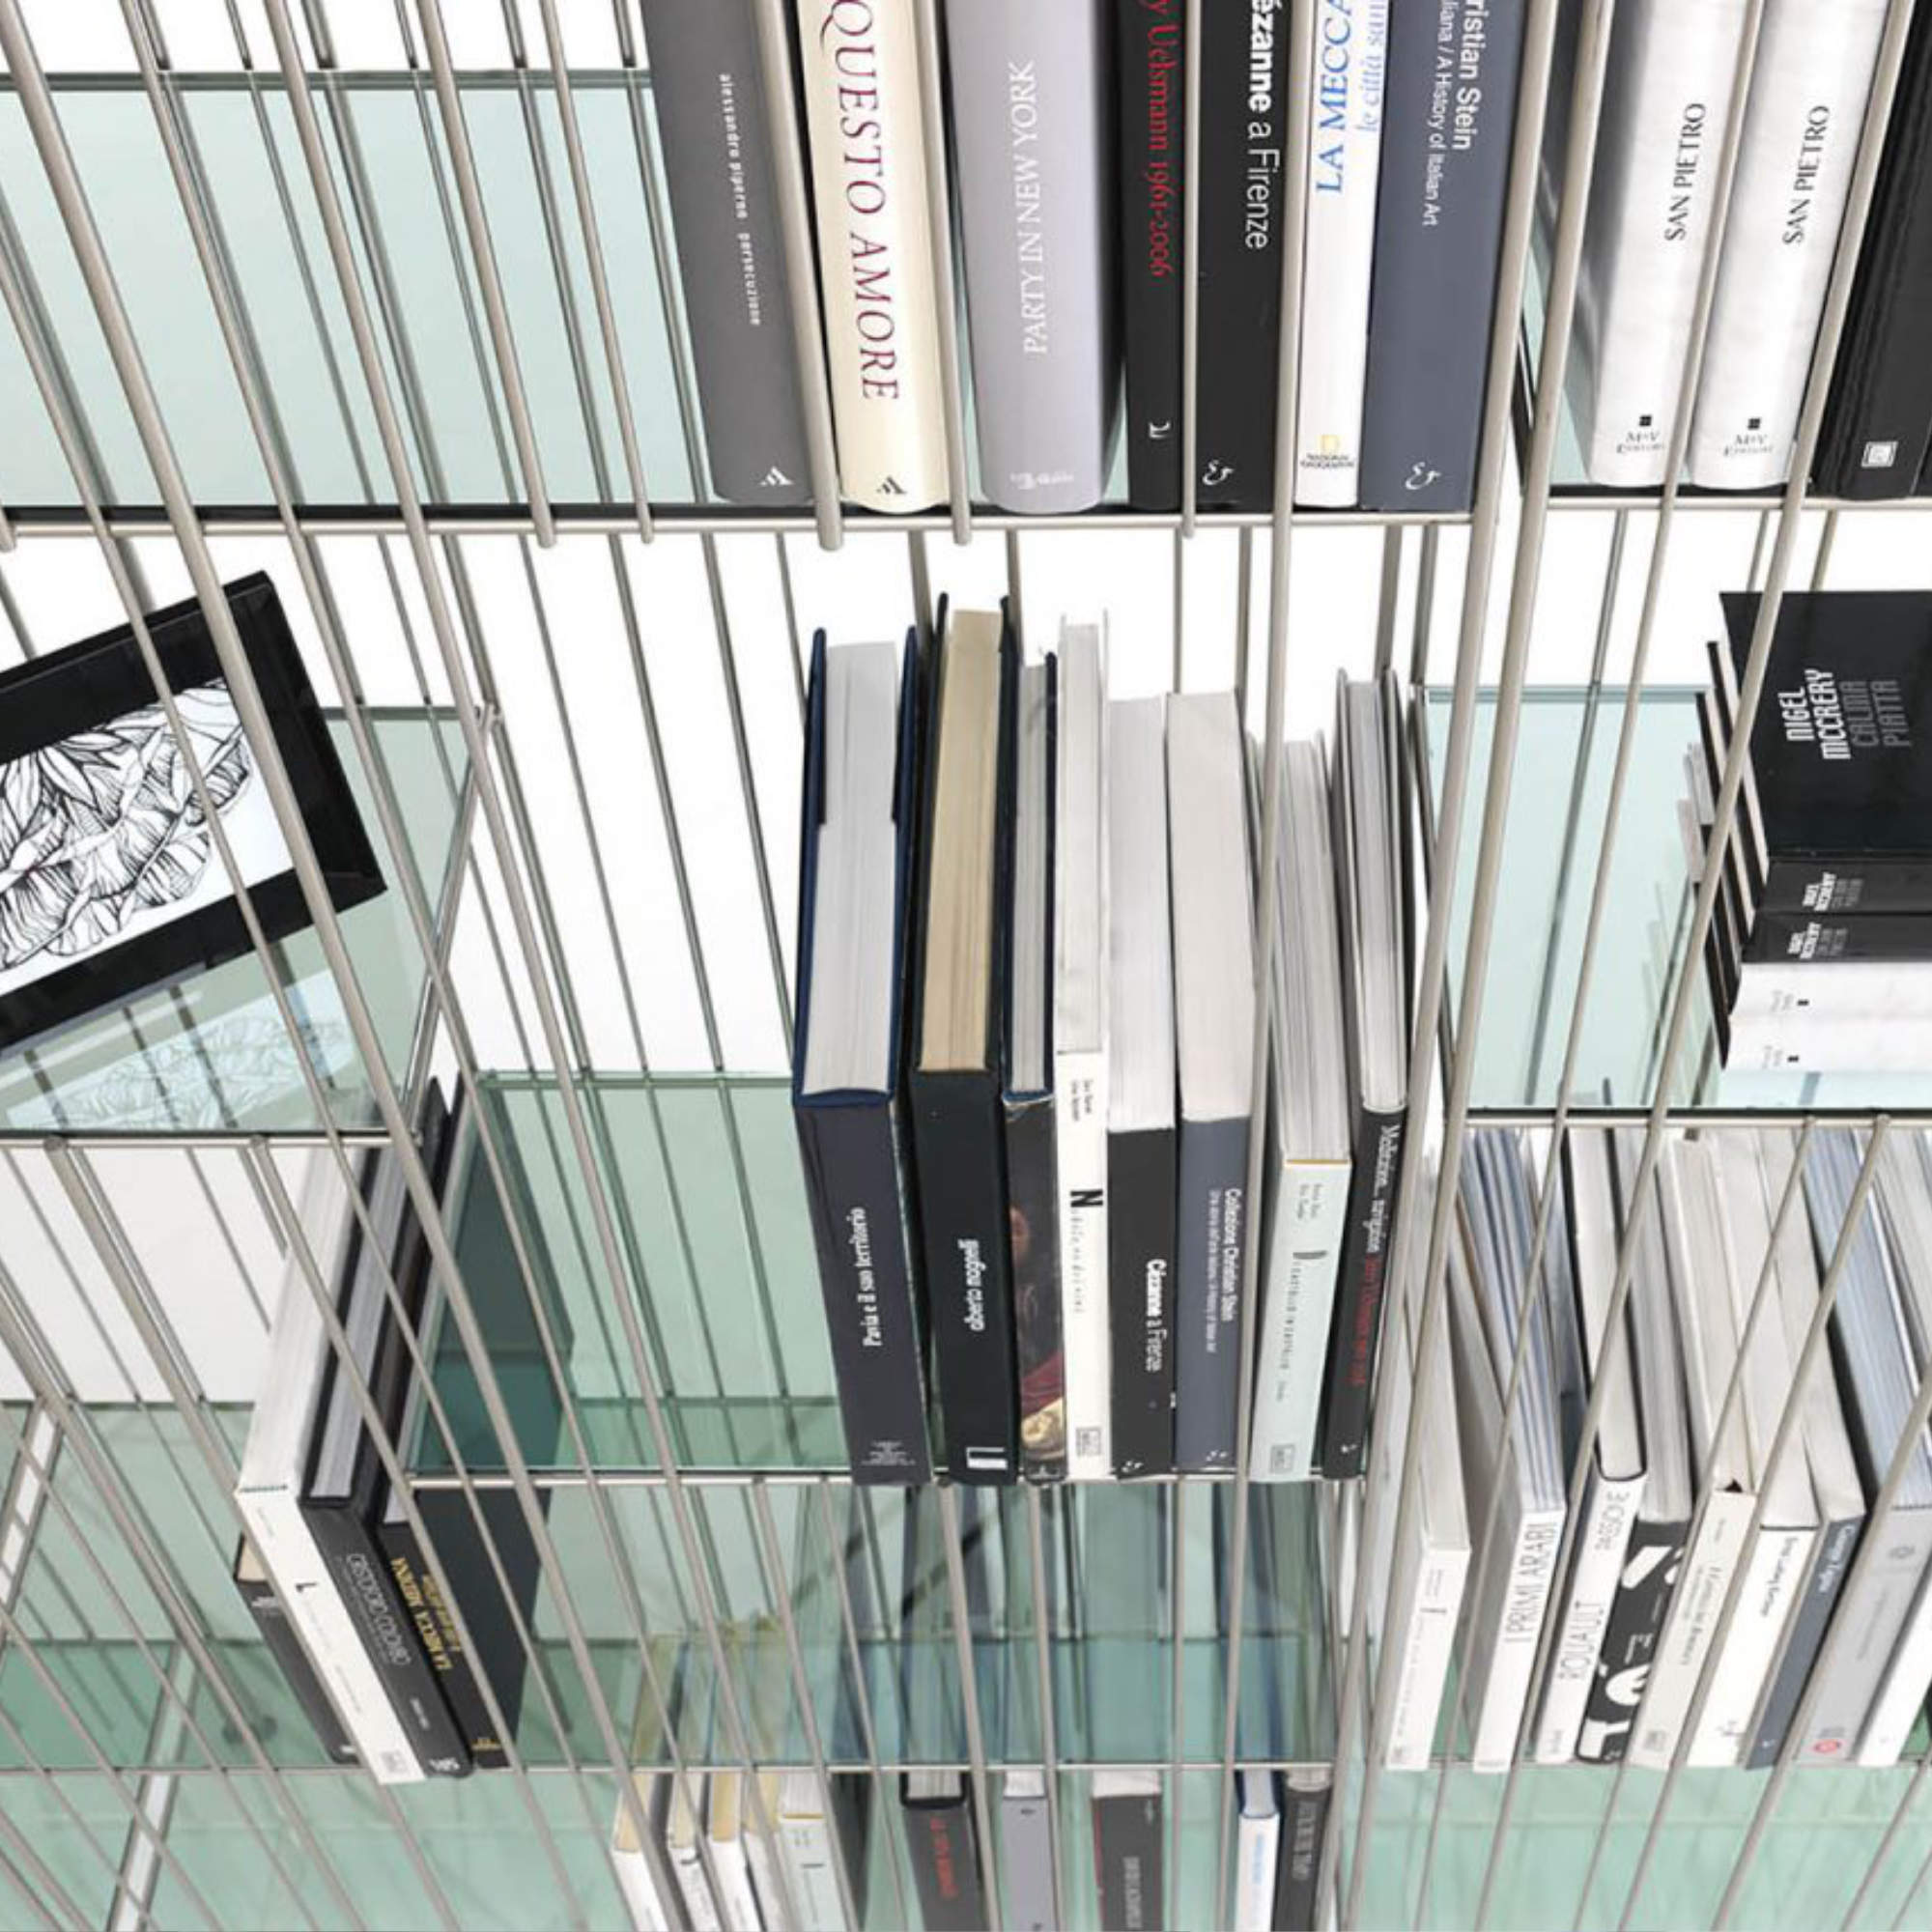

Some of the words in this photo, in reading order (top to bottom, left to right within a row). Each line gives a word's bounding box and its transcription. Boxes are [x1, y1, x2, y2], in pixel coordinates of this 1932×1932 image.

[1318, 0, 1353, 131] MECCA
[819, 0, 888, 215] QUESTO
[1009, 61, 1037, 156] YORK
[1247, 122, 1271, 139] a
[1427, 72, 1453, 129] History
[1452, 86, 1483, 151] Stein
[1315, 144, 1345, 194] LA
[1430, 133, 1448, 150] of
[1673, 101, 1708, 188] PIETRO
[1794, 104, 1831, 192] PIETRO
[1012, 158, 1042, 231] NEW
[1244, 149, 1280, 249] Firenze
[1422, 203, 1441, 227] Art
[1664, 194, 1691, 242] SAN
[1783, 198, 1810, 245] SAN
[1019, 233, 1044, 269] IN
[849, 231, 899, 401] AMORE
[1022, 271, 1048, 355] PARTY
[1777, 686, 1816, 742] NIGEL
[1804, 668, 1852, 760] MCCRERY
[1838, 680, 1880, 747] CALMA
[1870, 679, 1912, 748] PIATTA
